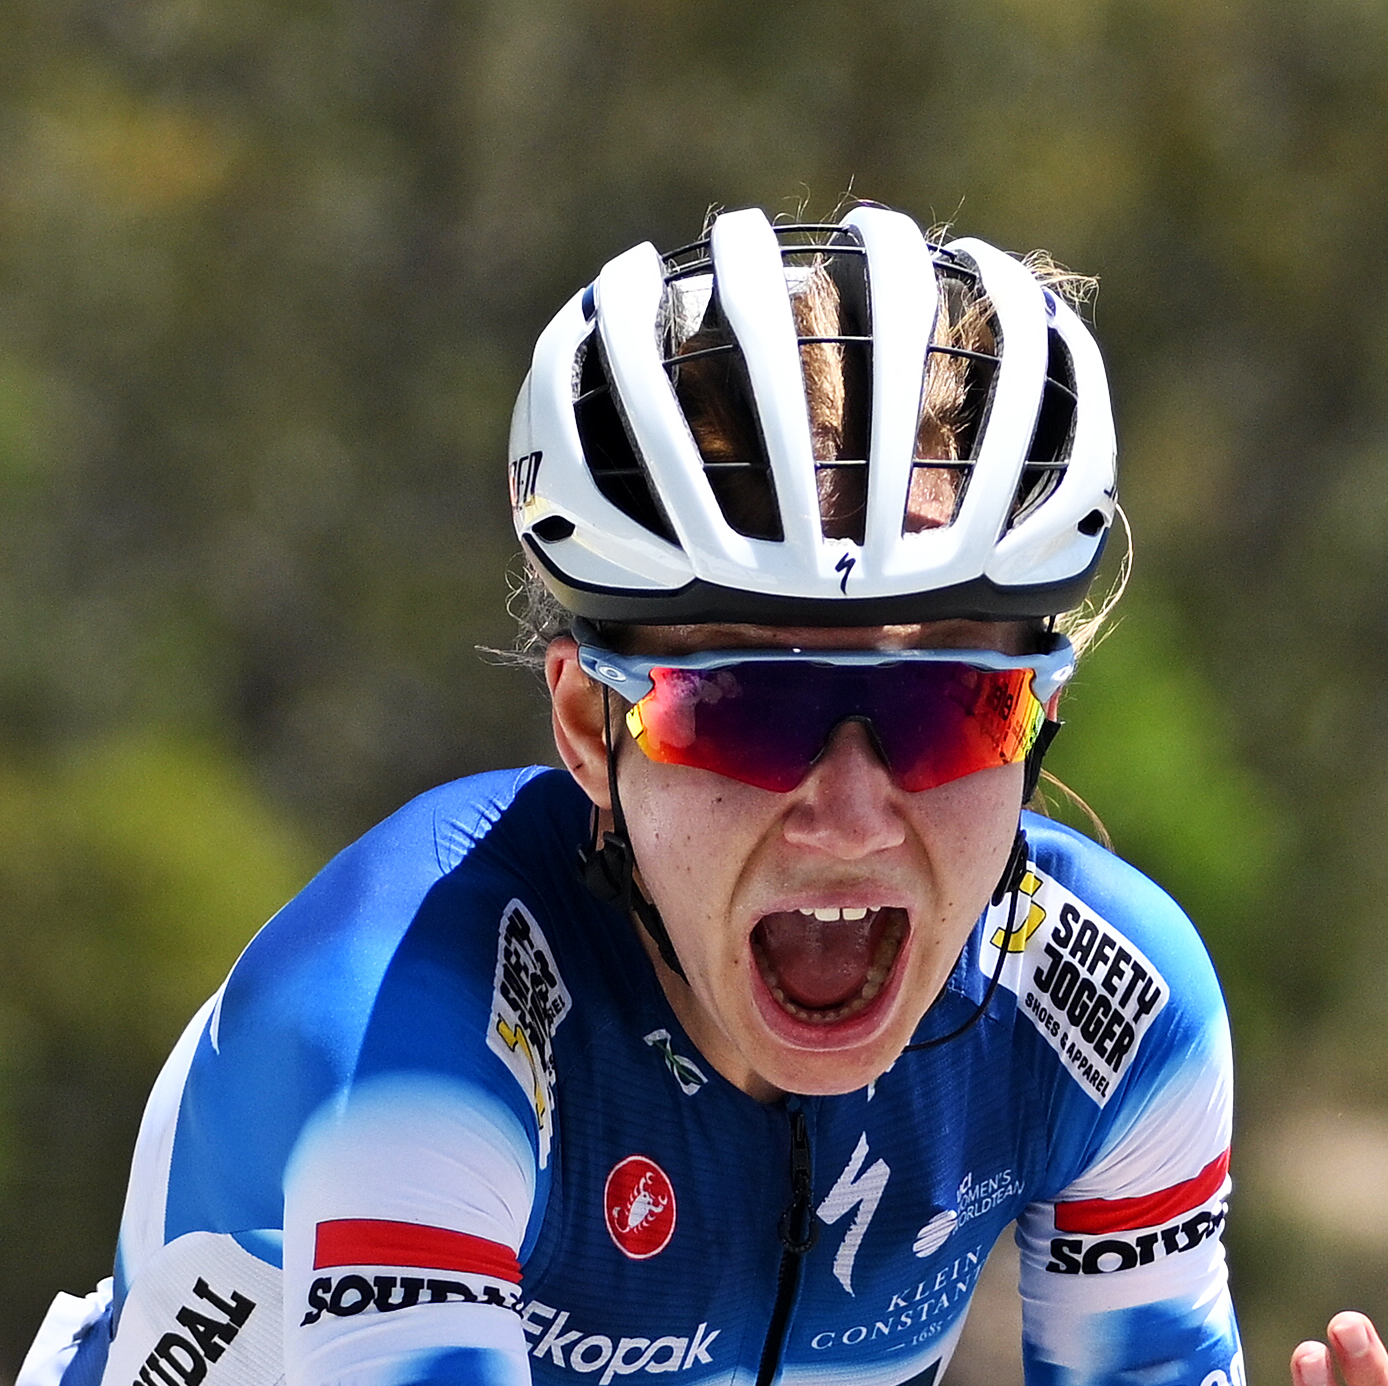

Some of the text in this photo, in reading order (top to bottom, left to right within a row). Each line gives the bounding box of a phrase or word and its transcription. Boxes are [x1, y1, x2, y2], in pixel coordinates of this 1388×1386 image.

[1033, 941, 1136, 1074] JOGGER
[1051, 902, 1162, 1025] SAFETY
[1025, 992, 1060, 1037] SHOES
[1066, 1042, 1110, 1098] APPAREL
[886, 1244, 983, 1312] KLEIN
[521, 1300, 722, 1386] Ekopak
